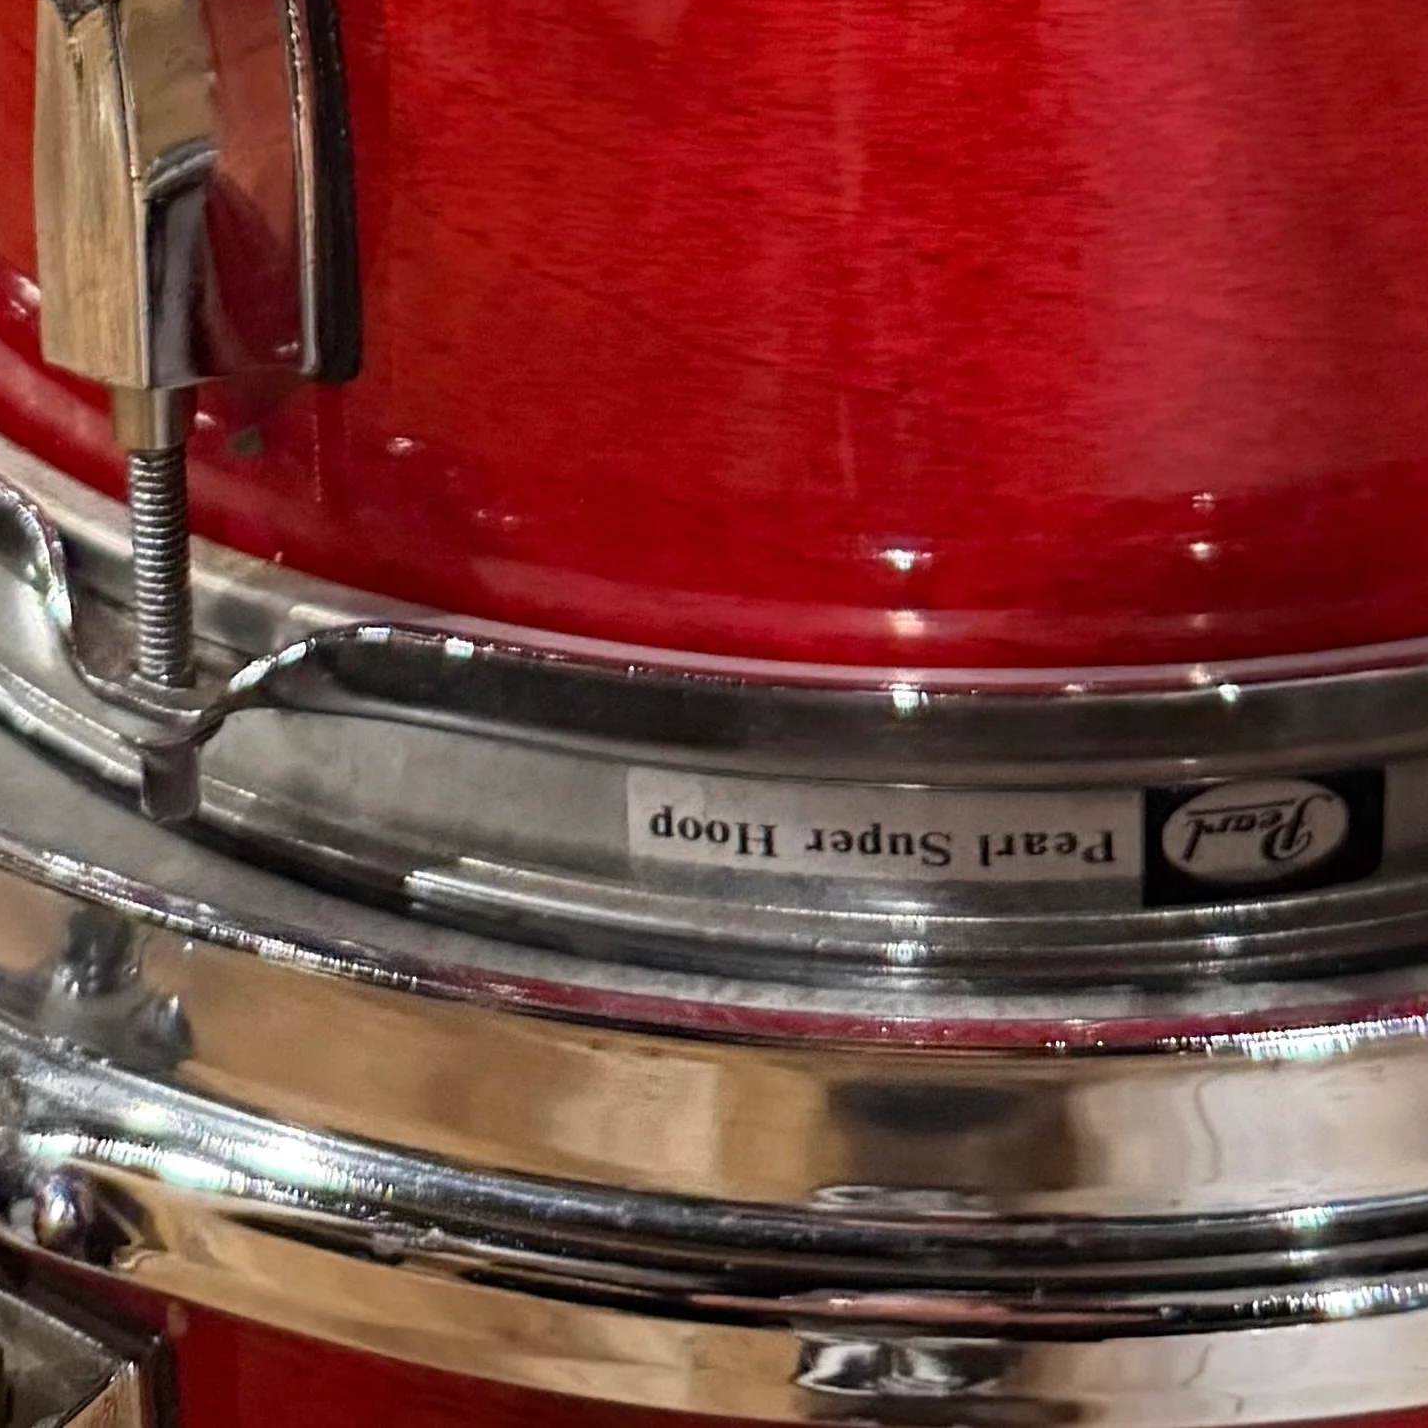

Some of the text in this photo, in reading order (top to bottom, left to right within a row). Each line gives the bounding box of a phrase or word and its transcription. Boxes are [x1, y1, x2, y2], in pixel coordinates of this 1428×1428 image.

[648, 804, 1115, 867] Pearl Super Hoop
[1182, 792, 1334, 864] Pearl
